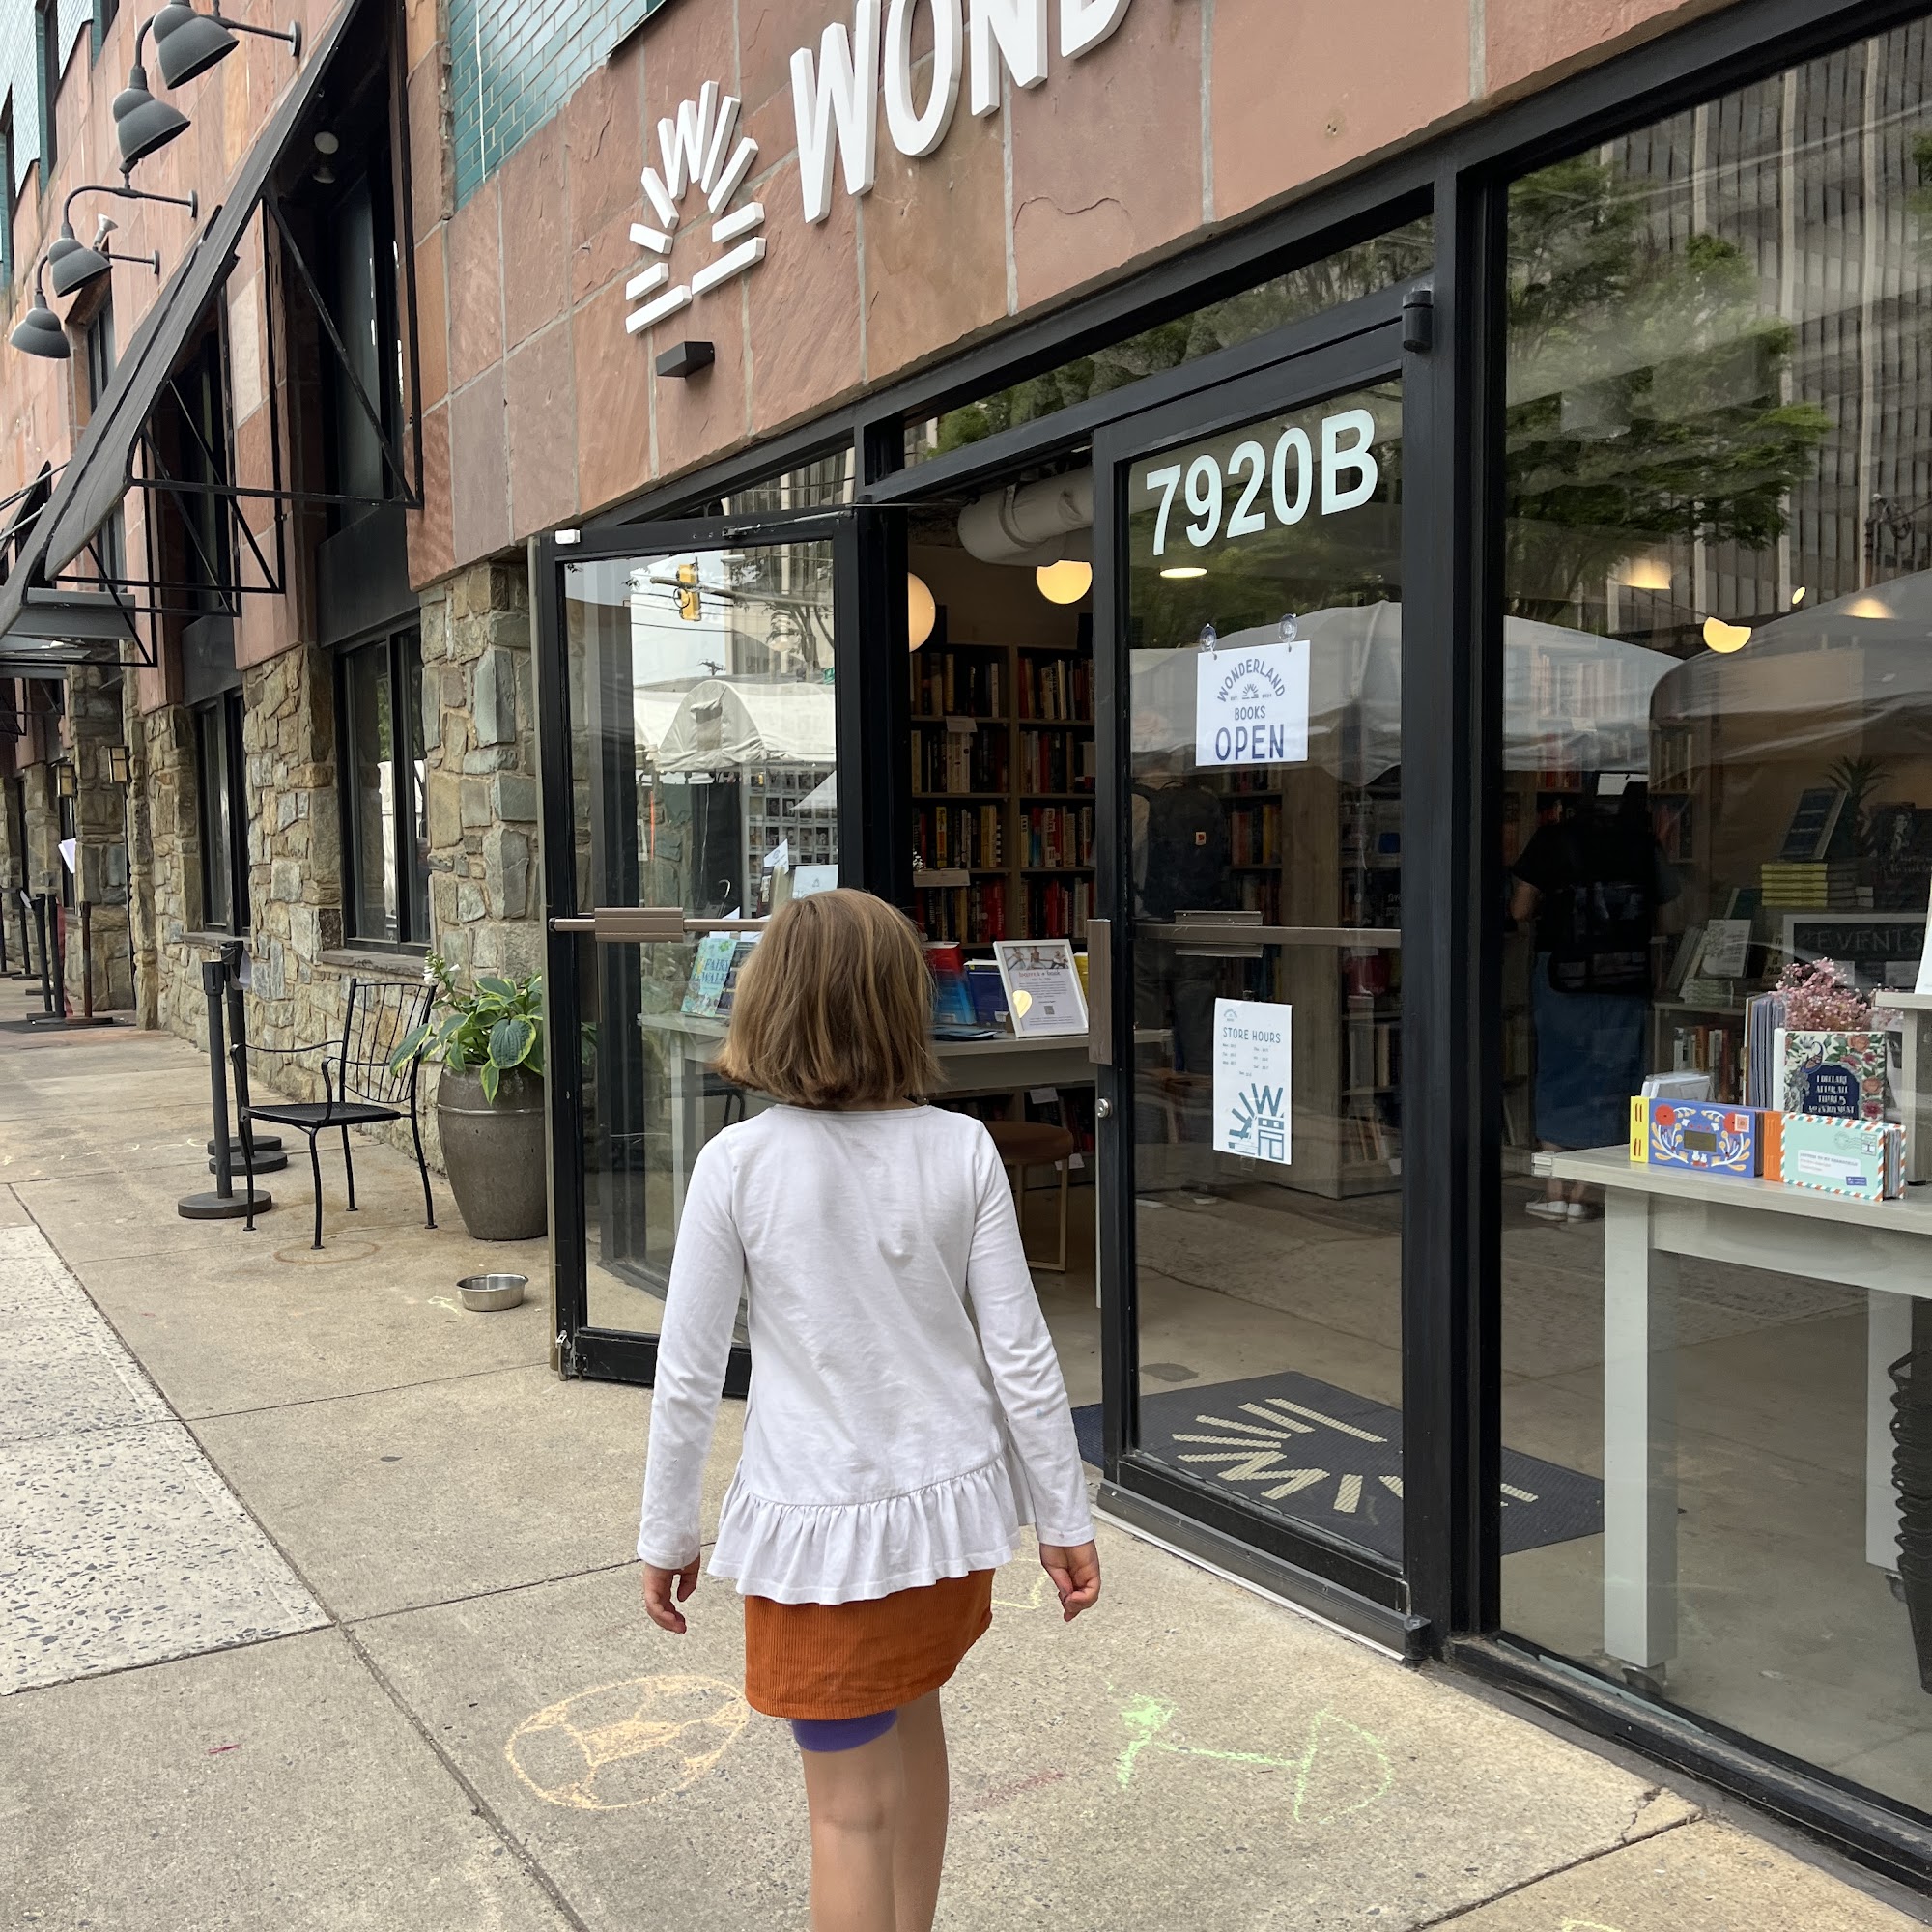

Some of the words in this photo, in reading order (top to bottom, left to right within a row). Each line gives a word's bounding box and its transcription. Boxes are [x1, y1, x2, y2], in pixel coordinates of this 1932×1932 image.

[1146, 408, 1378, 556] 7920B
[1217, 658, 1286, 703] WONDERLAND
[1235, 705, 1266, 721] BOOKS
[1215, 724, 1285, 761] OPEN
[1223, 1026, 1249, 1040] STORE
[1252, 1030, 1281, 1044] HOURS
